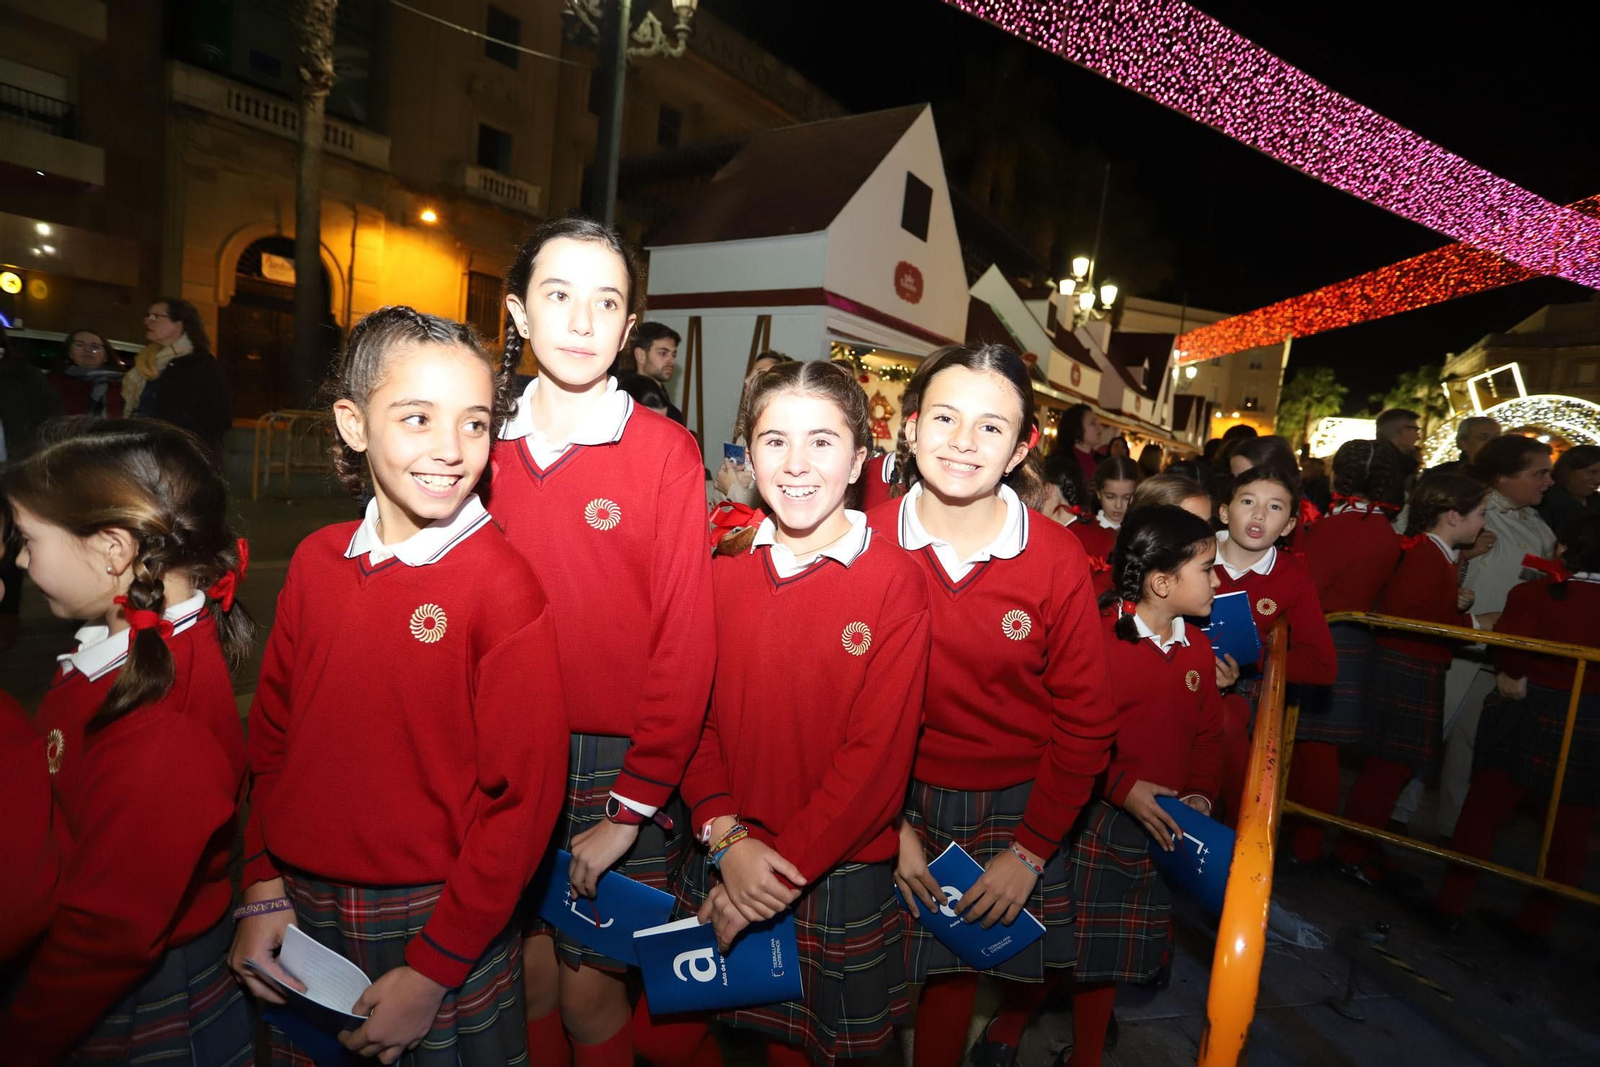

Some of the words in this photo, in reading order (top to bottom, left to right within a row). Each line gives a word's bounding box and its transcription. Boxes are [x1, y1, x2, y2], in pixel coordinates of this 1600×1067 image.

[692, 22, 772, 86] ANCO
[673, 947, 717, 982] a
[720, 964, 727, 972] de
